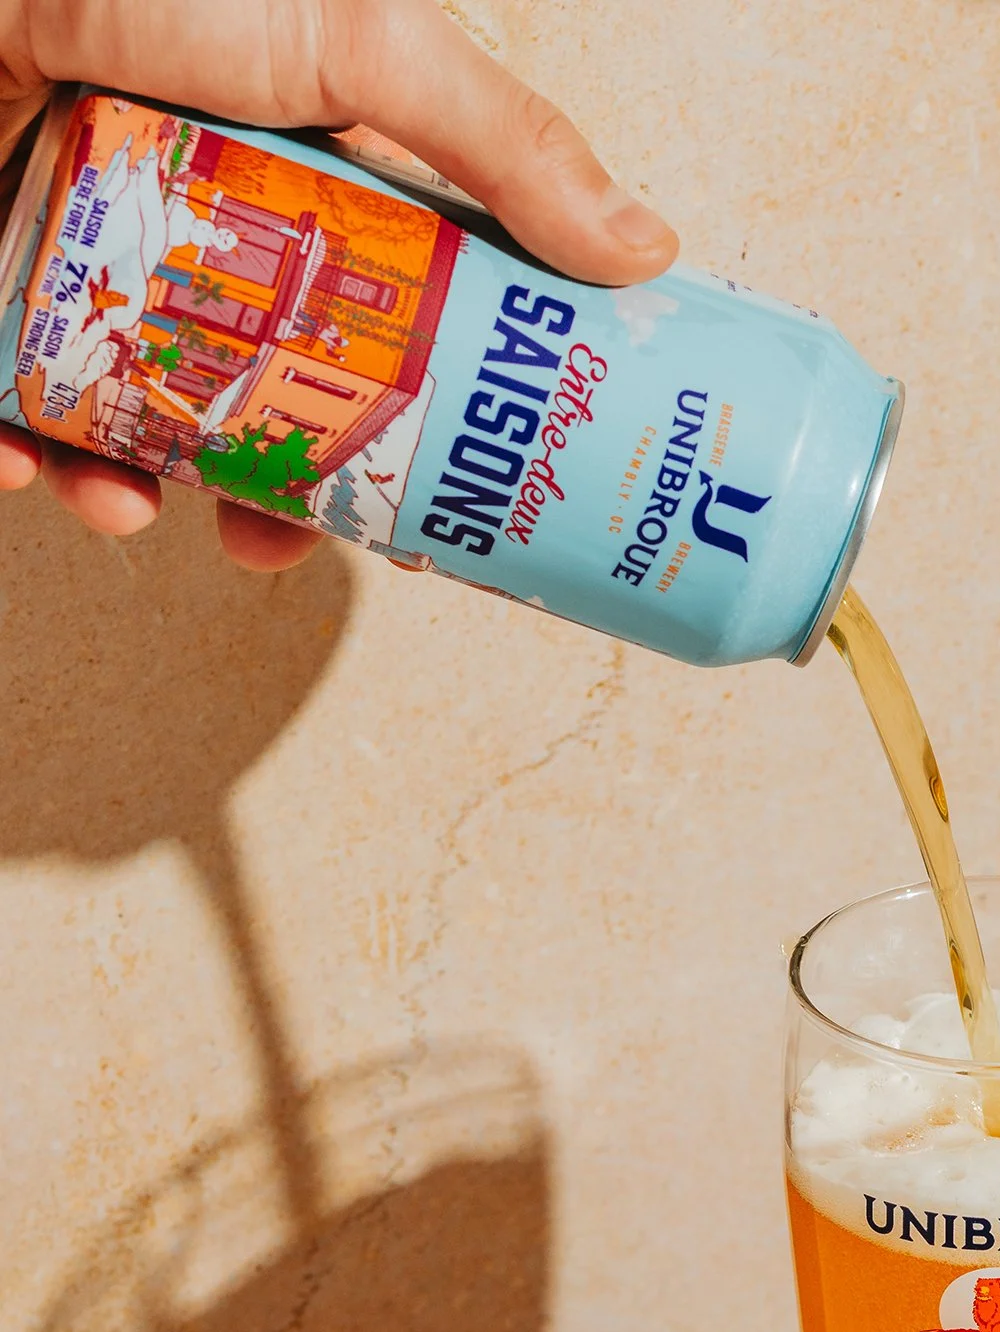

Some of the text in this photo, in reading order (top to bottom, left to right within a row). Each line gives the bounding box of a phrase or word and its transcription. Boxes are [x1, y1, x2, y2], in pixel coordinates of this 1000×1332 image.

[61, 166, 98, 241] BIÈRE FORTE
[80, 198, 109, 248] SAISON
[55, 261, 89, 304] 7%
[16, 308, 50, 376] STRONG BEER
[42, 315, 69, 359] SAISON
[48, 382, 80, 410] 473
[420, 284, 576, 557] SAISONS
[506, 343, 607, 545] Entre-deux
[619, 425, 657, 501] CHAMBLY
[709, 403, 734, 467] BRASSERIE
[611, 389, 708, 587] UNIBROUE
[655, 541, 692, 593] BREWERY
